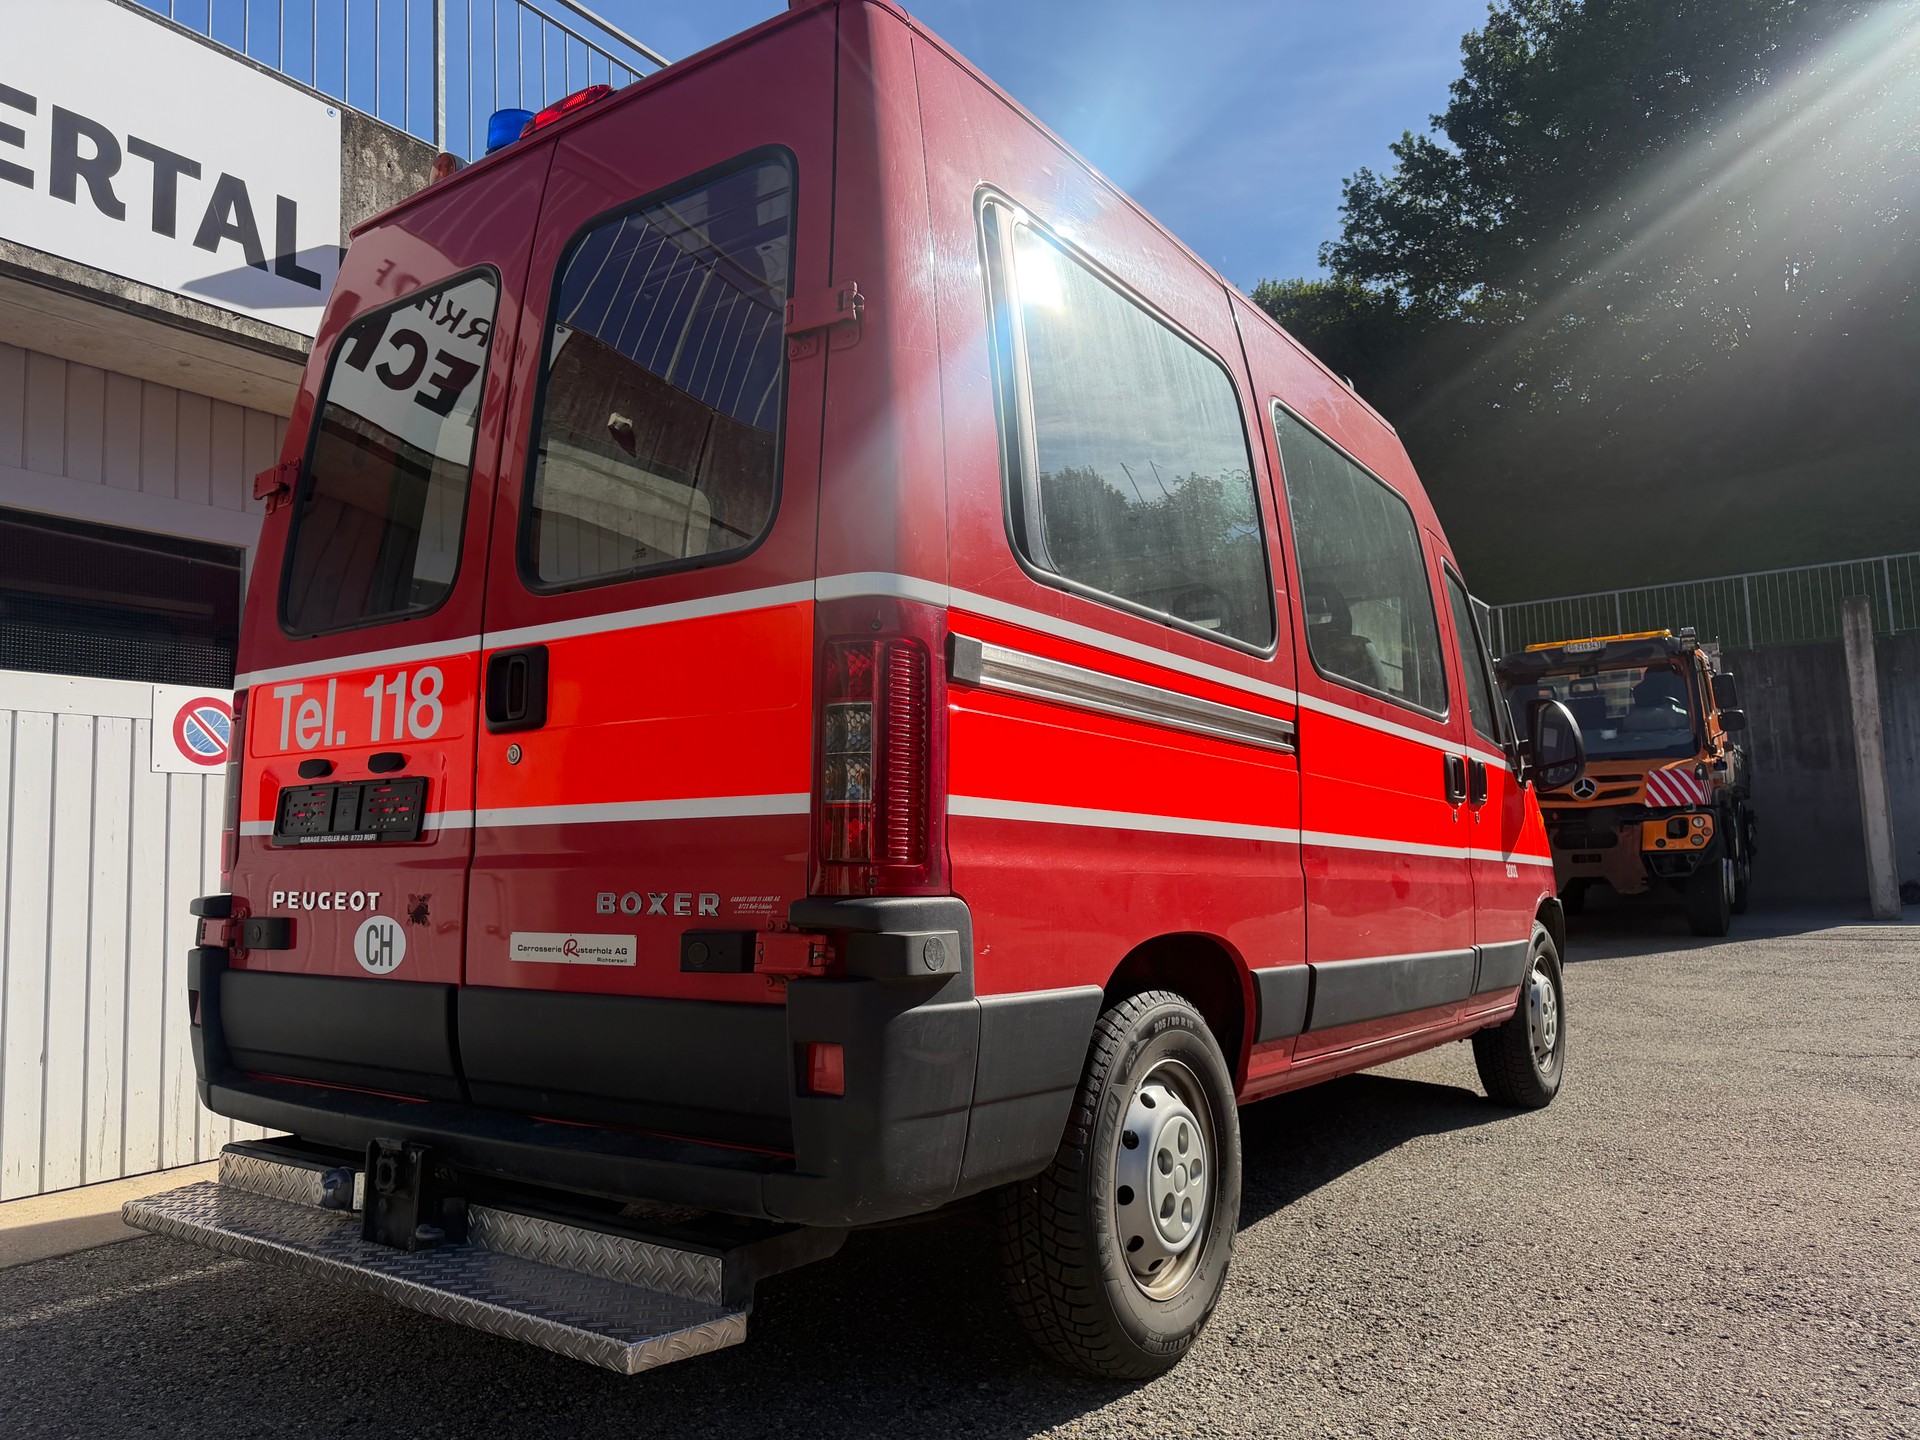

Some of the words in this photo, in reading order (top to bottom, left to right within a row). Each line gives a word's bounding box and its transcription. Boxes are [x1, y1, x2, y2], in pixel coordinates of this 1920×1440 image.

[0, 83, 321, 290] ERTAL
[273, 678, 346, 751] Tel.
[363, 666, 444, 742] 118
[272, 890, 381, 912] PEUGEOT
[596, 891, 720, 916] BOXER
[366, 924, 394, 967] CH
[517, 944, 562, 953] Carrosserie
[563, 938, 612, 957] Rusterholz
[614, 947, 628, 955] AG
